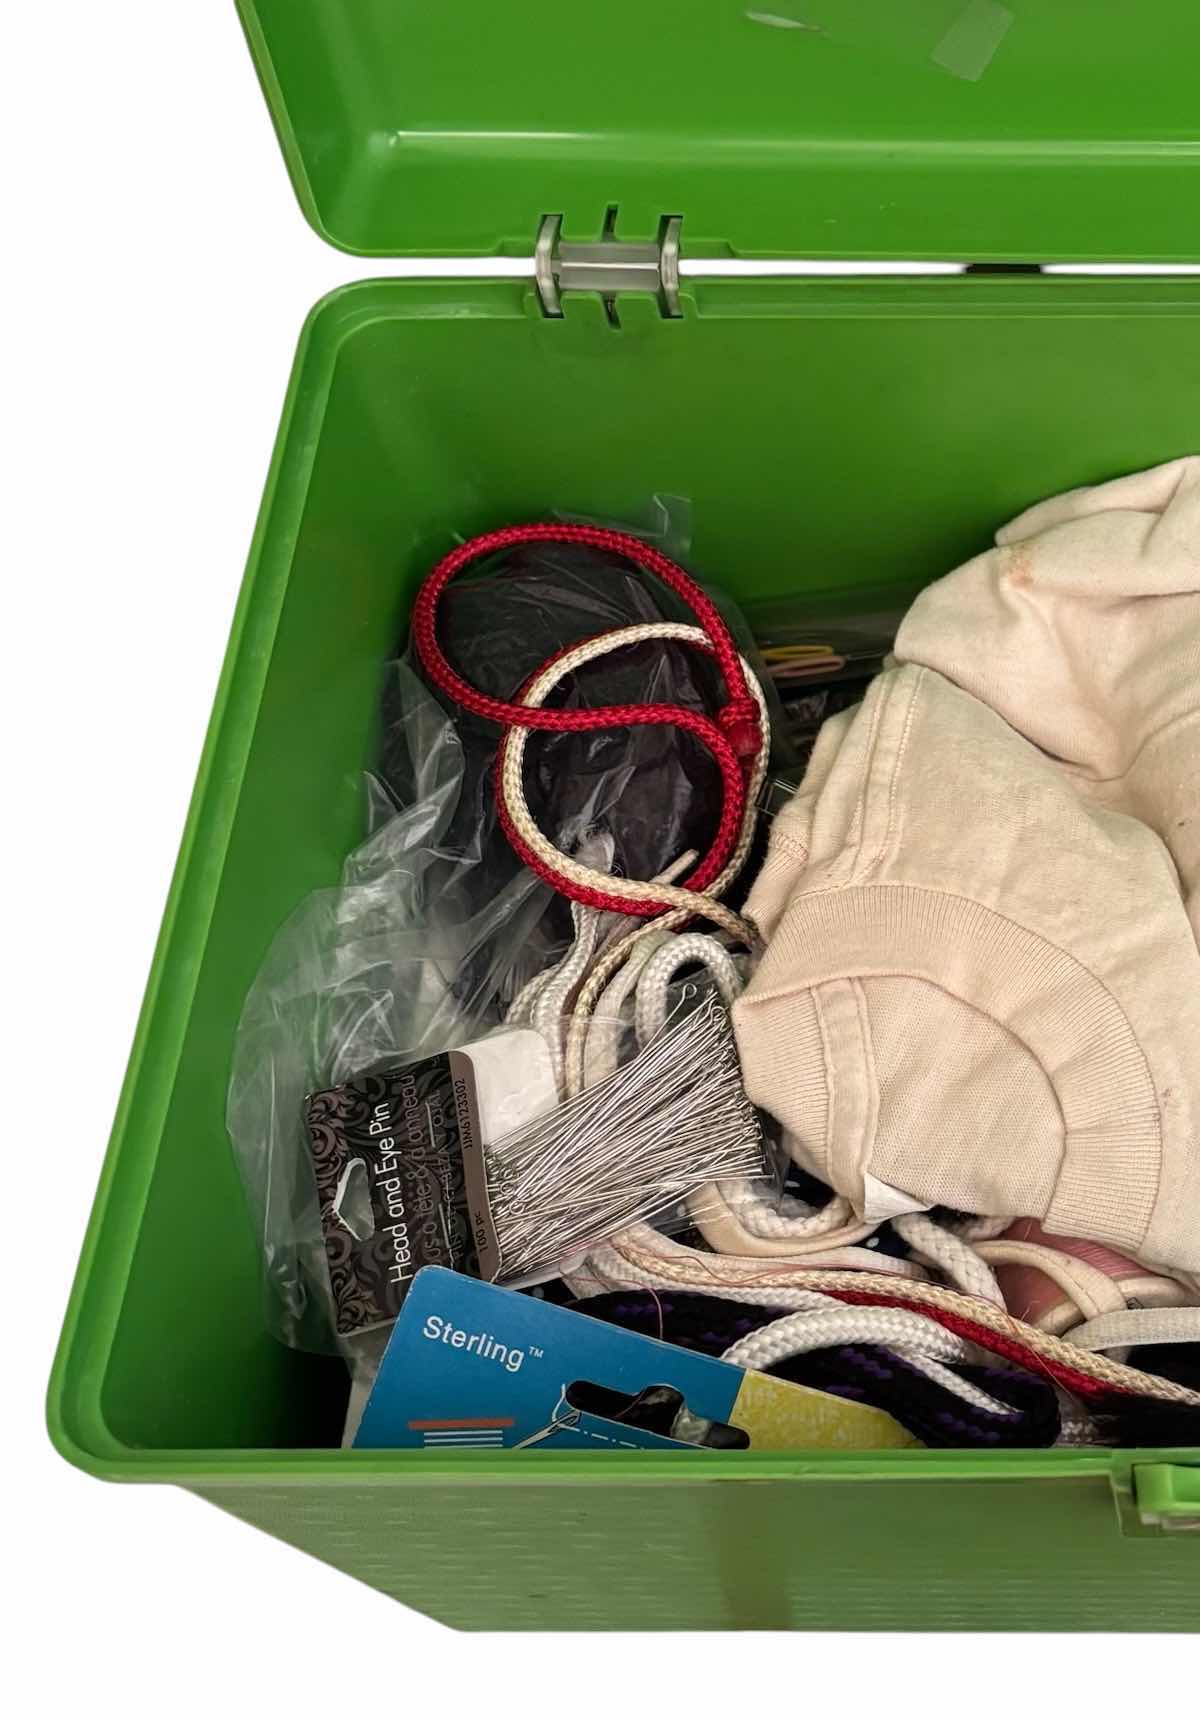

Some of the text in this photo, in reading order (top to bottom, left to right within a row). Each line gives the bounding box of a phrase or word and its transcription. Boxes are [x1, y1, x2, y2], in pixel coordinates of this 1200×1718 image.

[369, 1103, 413, 1283] Head and Eye Pin
